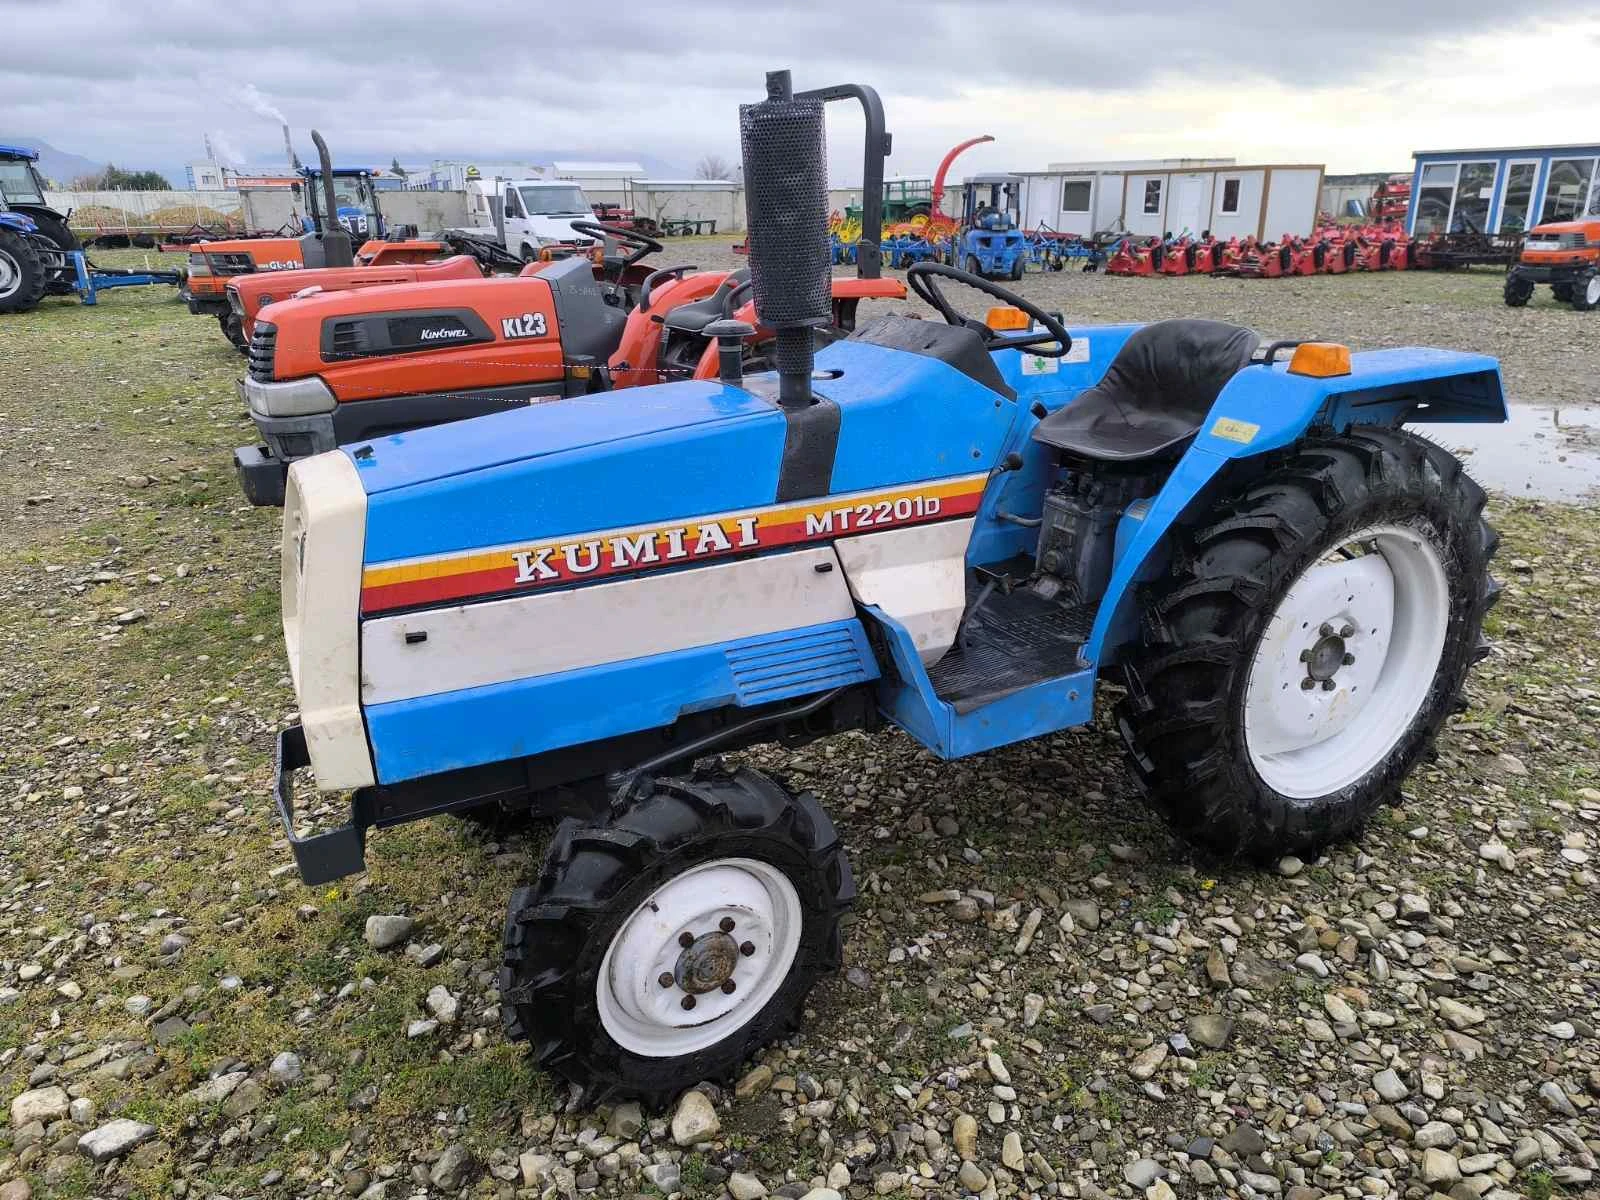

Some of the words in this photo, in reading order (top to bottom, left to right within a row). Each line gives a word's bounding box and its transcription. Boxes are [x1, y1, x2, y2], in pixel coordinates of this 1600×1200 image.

[501, 312, 547, 338] KL23
[512, 517, 760, 584] KUMIAI
[805, 496, 941, 535] MT2201D
